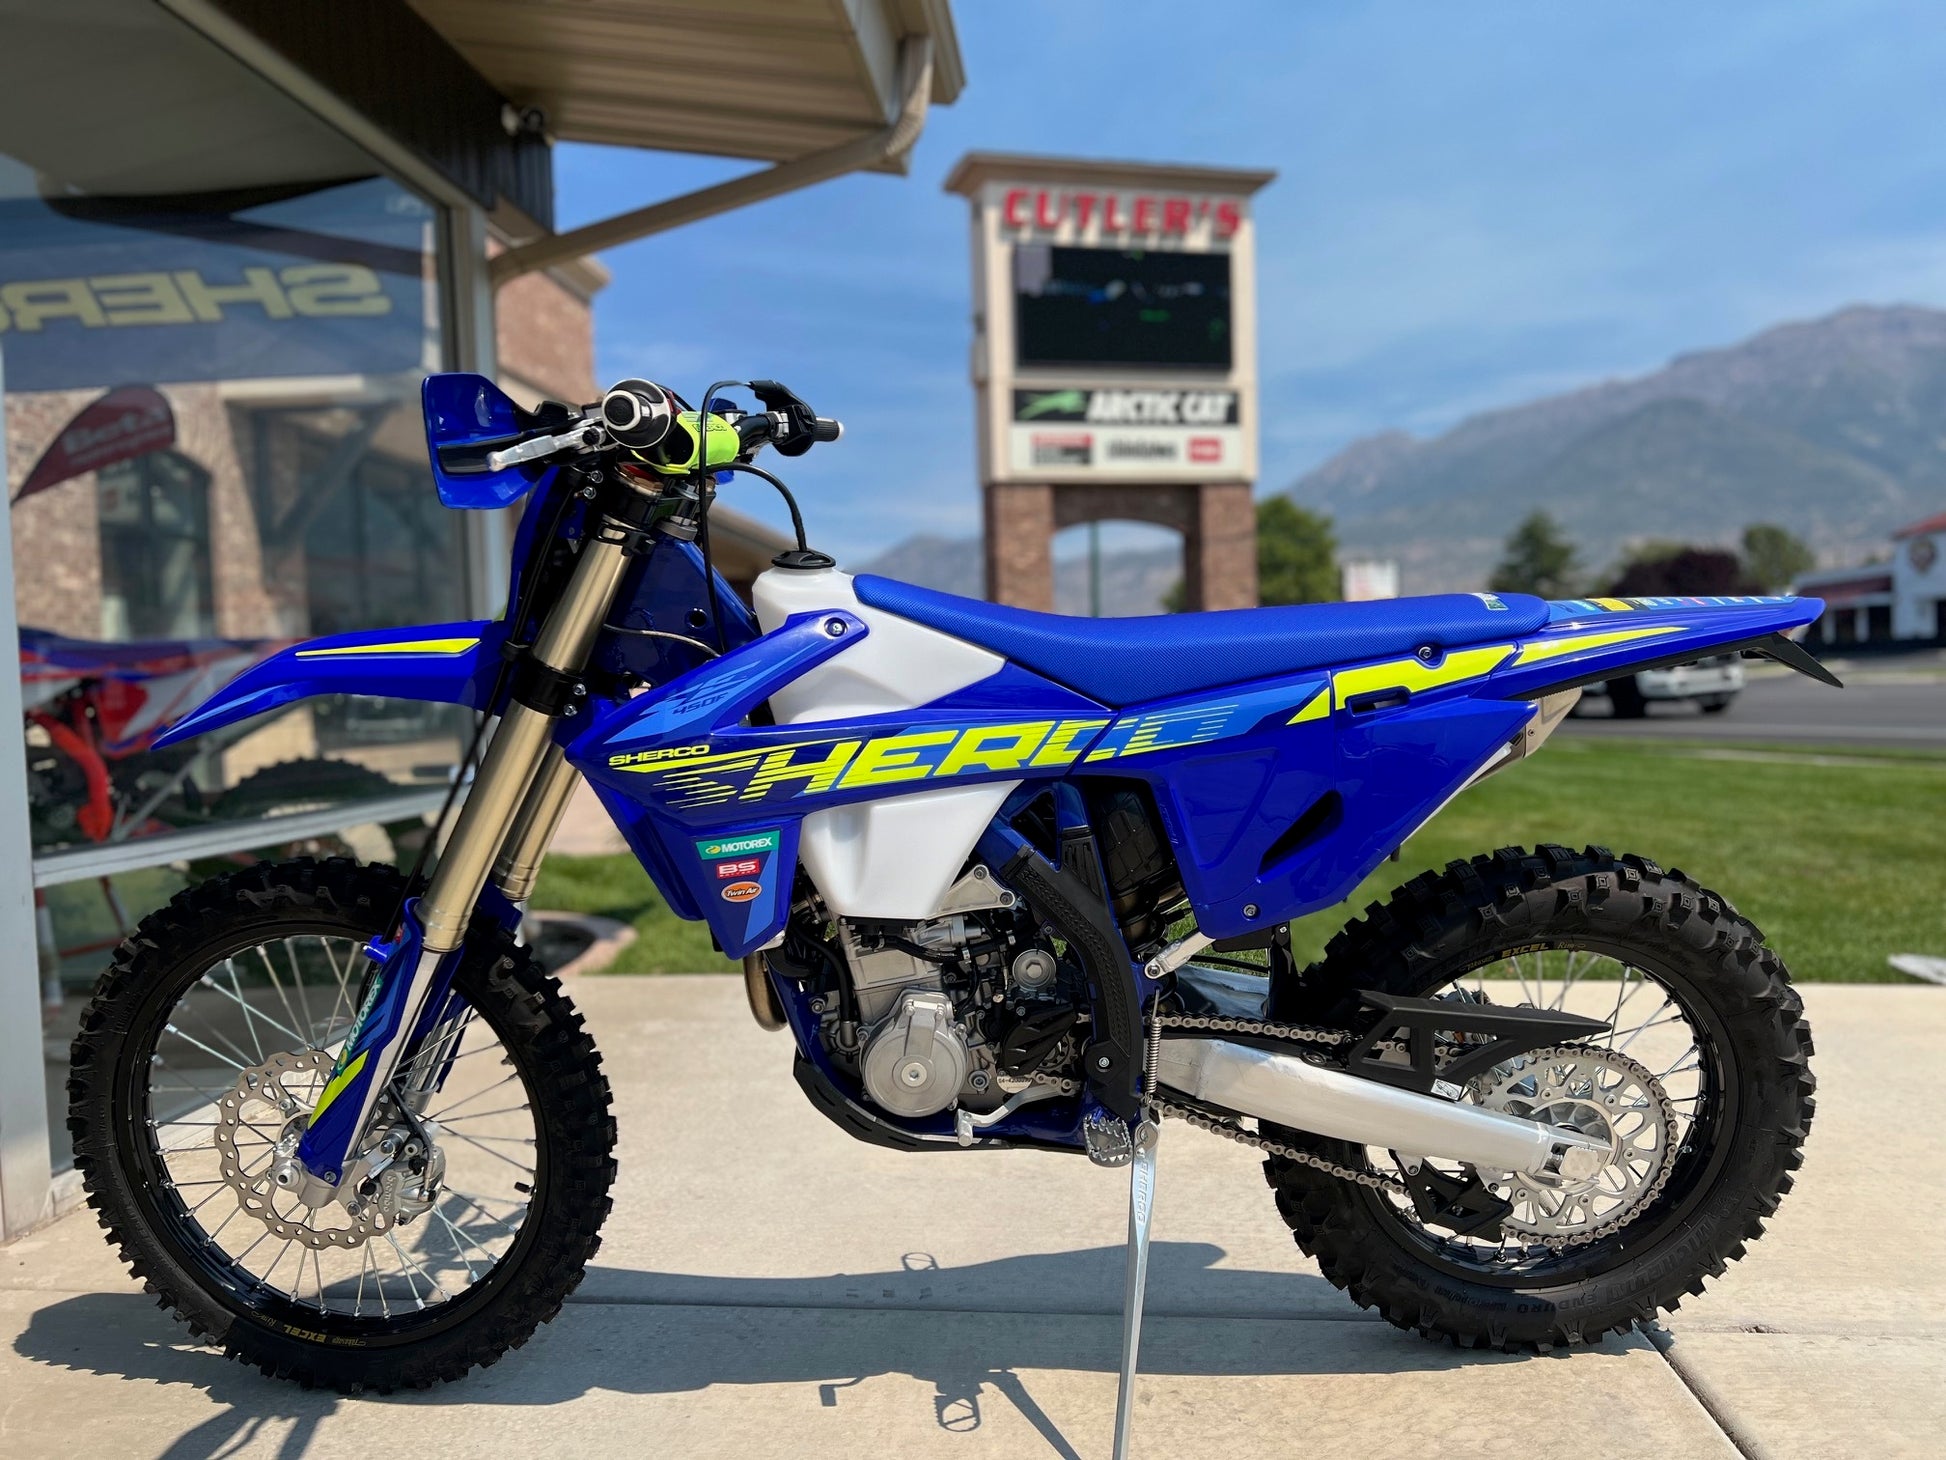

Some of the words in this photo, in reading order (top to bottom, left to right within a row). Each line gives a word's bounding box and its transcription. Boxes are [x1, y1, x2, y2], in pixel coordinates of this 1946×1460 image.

[1003, 189, 1242, 236] CUTLER'S
[1182, 390, 1234, 422] CAT
[672, 692, 729, 715] 450F
[608, 744, 710, 766] SHERCO
[721, 837, 772, 853] MOTOREX
[718, 861, 756, 875] BS
[726, 889, 746, 898] Twin
[746, 887, 759, 895] Air
[1501, 942, 1550, 959] EXCEL
[346, 980, 383, 1050] MOTOREX
[383, 1175, 397, 1212] brembo
[283, 1323, 328, 1344] EXCEL
